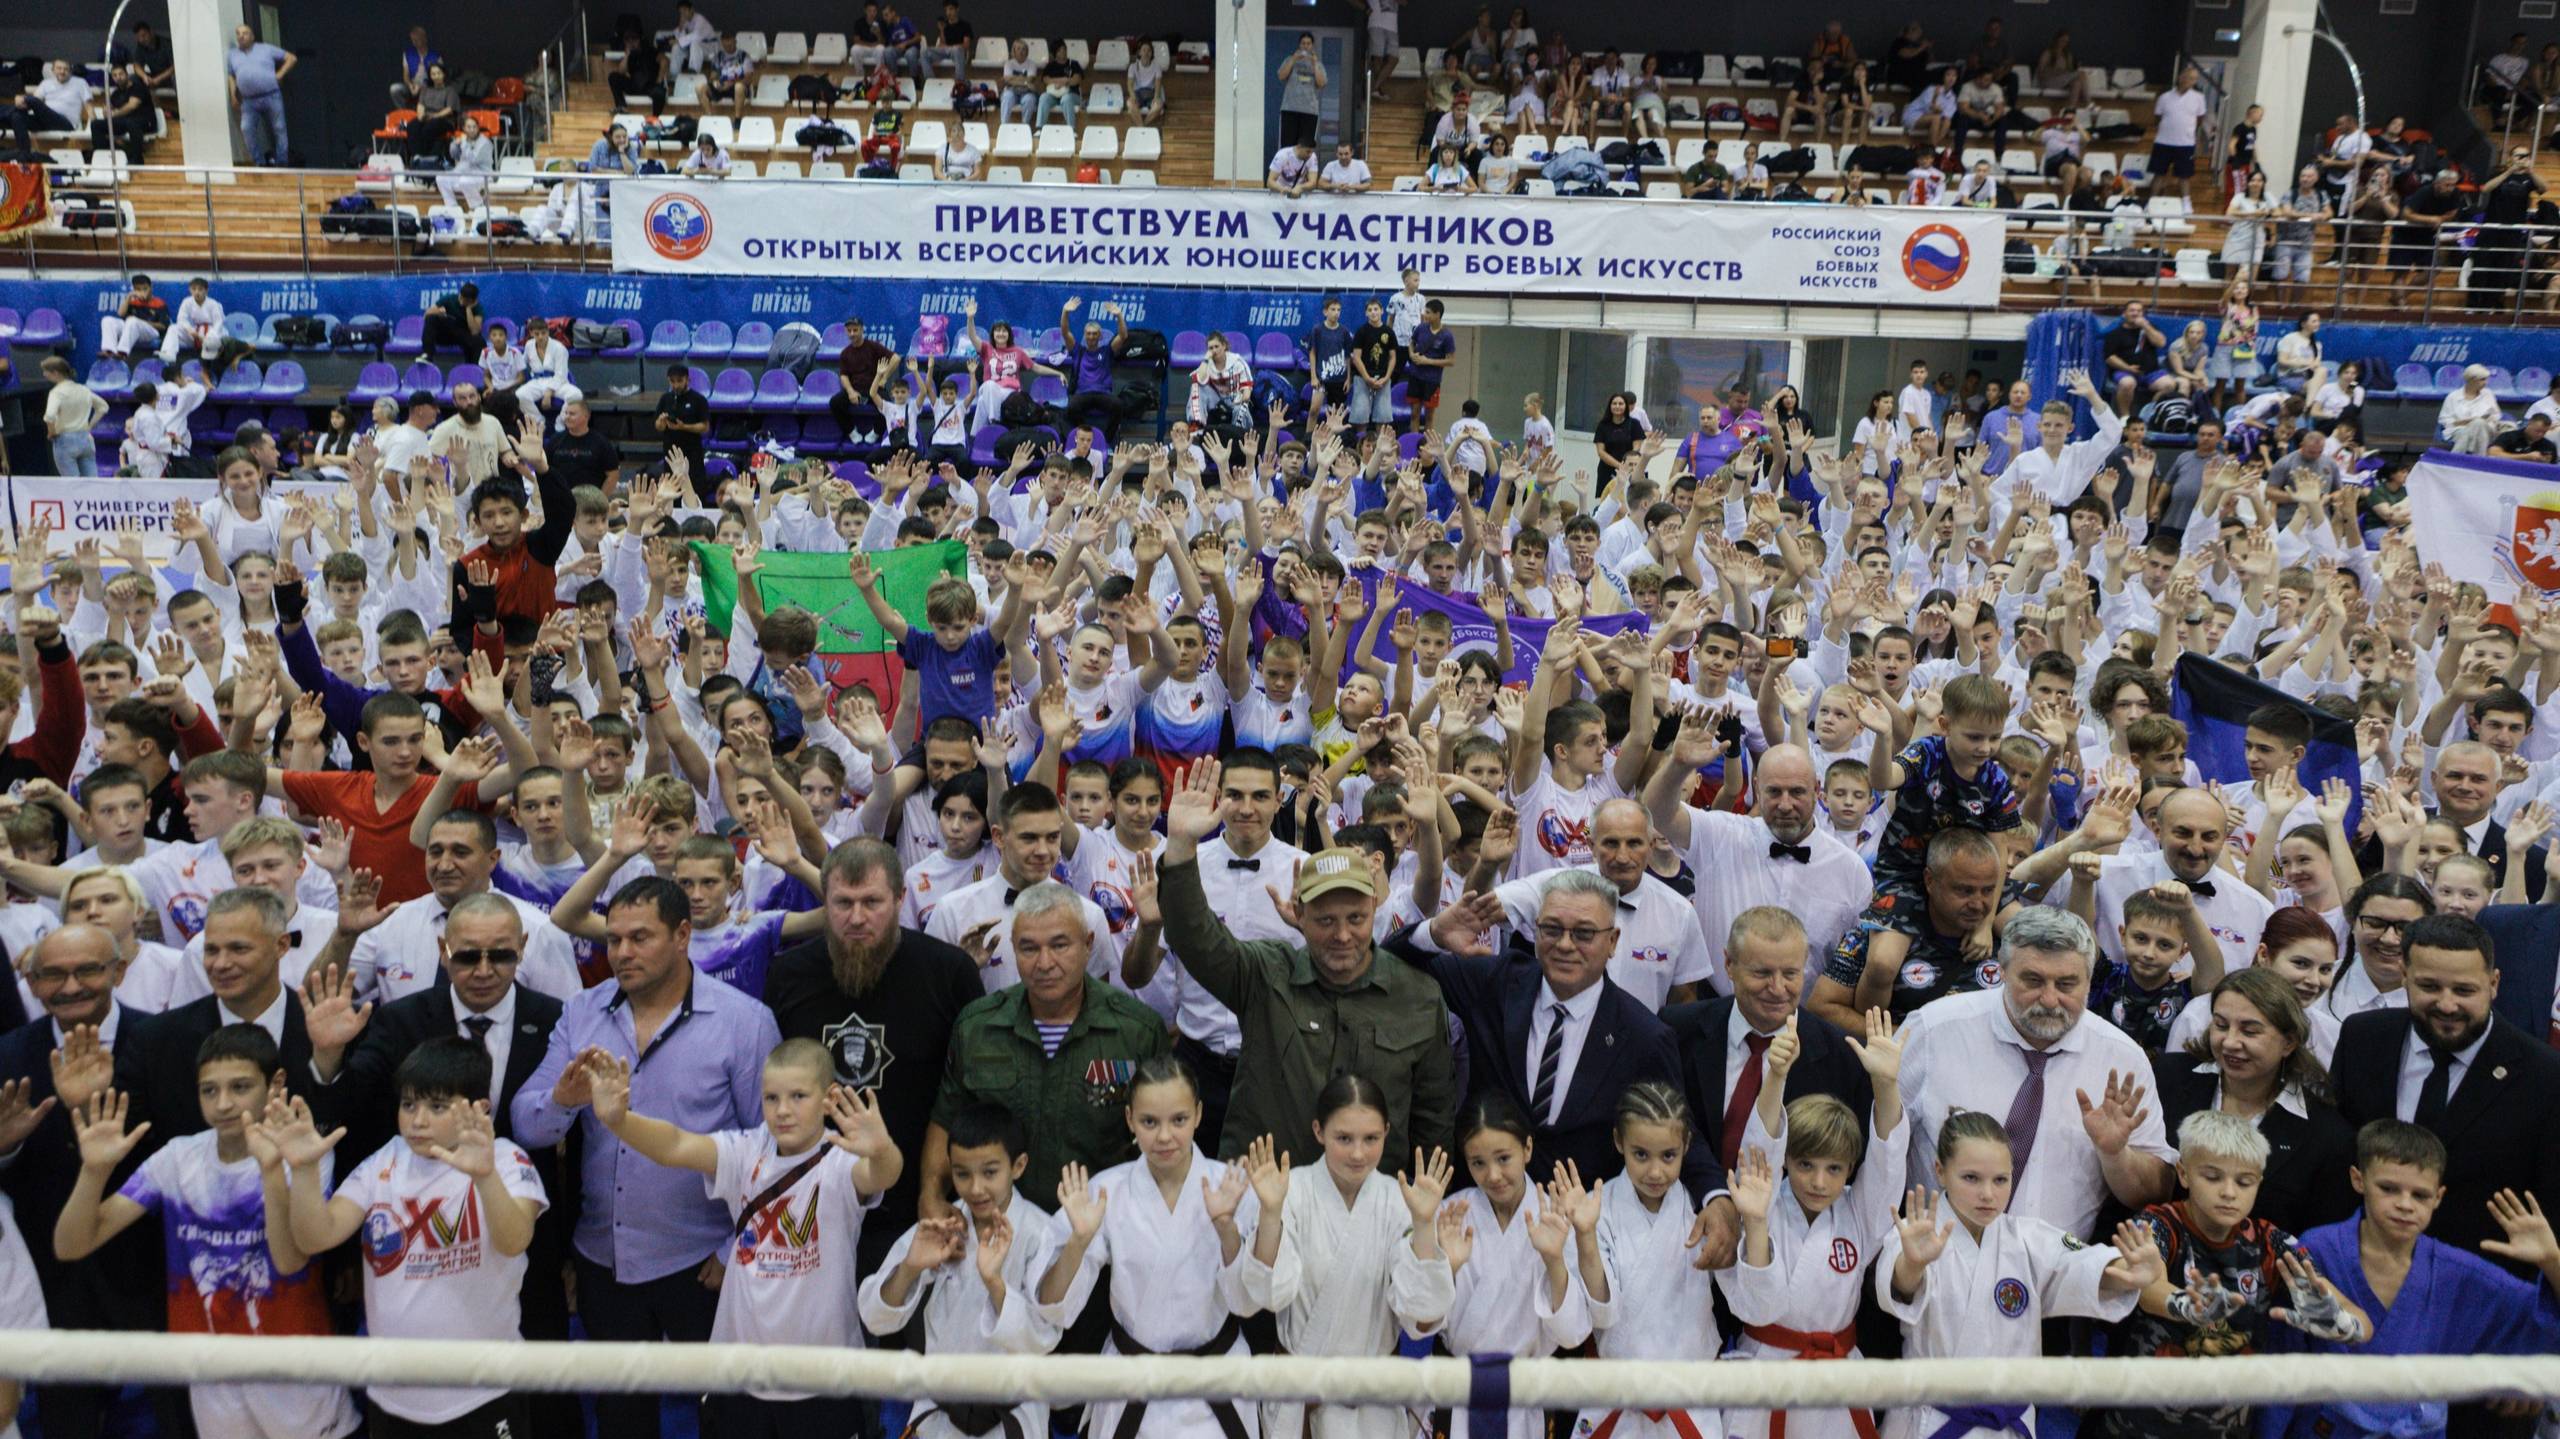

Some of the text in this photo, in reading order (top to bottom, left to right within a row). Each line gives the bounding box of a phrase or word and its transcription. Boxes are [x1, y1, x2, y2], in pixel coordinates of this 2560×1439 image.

[935, 204, 1554, 246] ПРИВЕТСТВУЕМ УЧАСТНИКОВ
[1772, 226, 1881, 241] РОССИЙСКИЙ
[743, 238, 1743, 281] ОТКРЫТЫХ ВСЕРОССИЙСКИХ ЮНОШЕСКИХ ИГР БОЕВЫХ ИСКУССТВ
[1834, 245, 1880, 257] СОЮЗ
[1816, 260, 1878, 273] БОЕВЫХ
[1800, 275, 1877, 289] ИСКУССТВ
[261, 290, 318, 312] ВИТЯЗЬ
[585, 289, 642, 310] ВИТЯЗЬ
[751, 293, 812, 313] ВИТЯЗЬ
[1249, 306, 1301, 327] ВИТЯЗЬ
